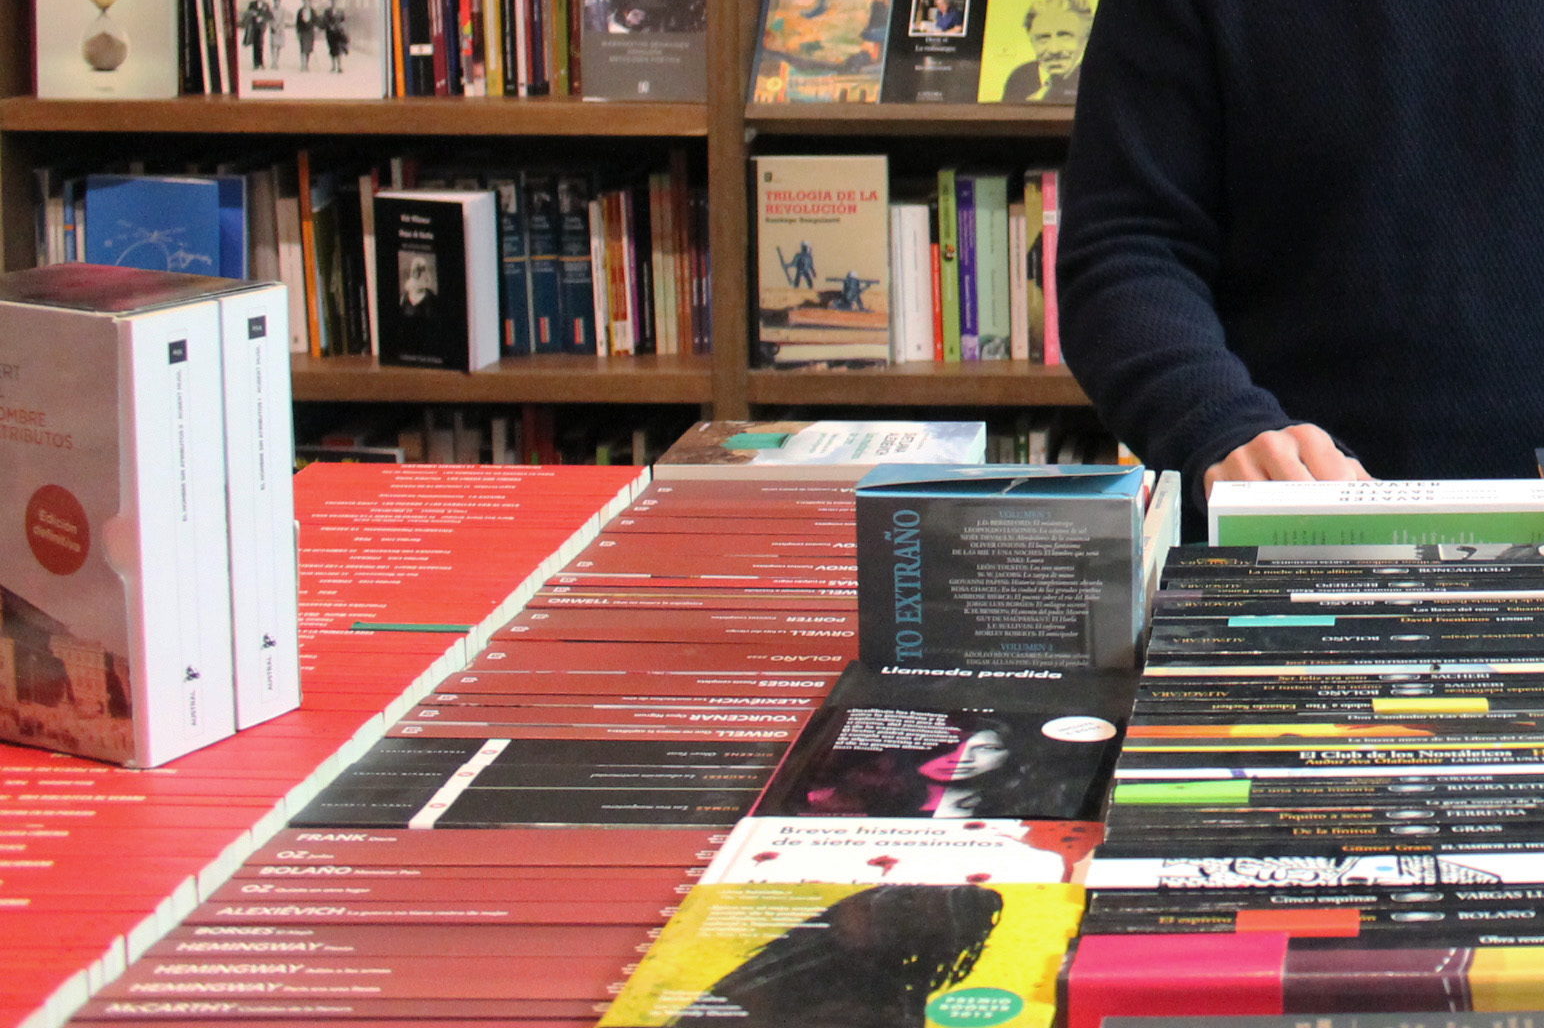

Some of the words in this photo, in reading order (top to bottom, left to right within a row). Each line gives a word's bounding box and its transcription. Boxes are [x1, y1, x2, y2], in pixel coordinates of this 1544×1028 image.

[766, 190, 832, 201] TRILOGÍA
[837, 190, 855, 201] DE
[860, 190, 878, 201] LA
[766, 203, 857, 214] REVOLUCIÓN
[771, 654, 842, 662] BOLAÑO
[881, 666, 972, 677] Llamada
[978, 669, 1062, 680] perdida
[760, 680, 825, 688] BORGES
[710, 697, 811, 705] ALEXIÉVICH
[689, 714, 797, 722] YOURCENAR
[716, 730, 788, 738] ORWELL
[1300, 751, 1316, 759] El
[1321, 751, 1363, 759] Club
[1390, 750, 1414, 758] los
[780, 825, 847, 836] Breve
[856, 825, 946, 836] historia
[297, 833, 366, 842] FRANK
[773, 837, 802, 848] de
[810, 837, 867, 848] siete
[875, 837, 1004, 849] asesinatos
[259, 865, 352, 876] BOLAÑO
[1456, 891, 1522, 900] VARGAS
[217, 903, 346, 917] ALEXIÉVICH
[1458, 910, 1536, 920] BOLAÑO
[195, 926, 274, 936] BORGES
[1479, 935, 1514, 944] Obra
[177, 941, 324, 952] HEMINGWAY
[154, 963, 305, 975] HEMINGWAY
[130, 982, 283, 993] HEMINGWAY
